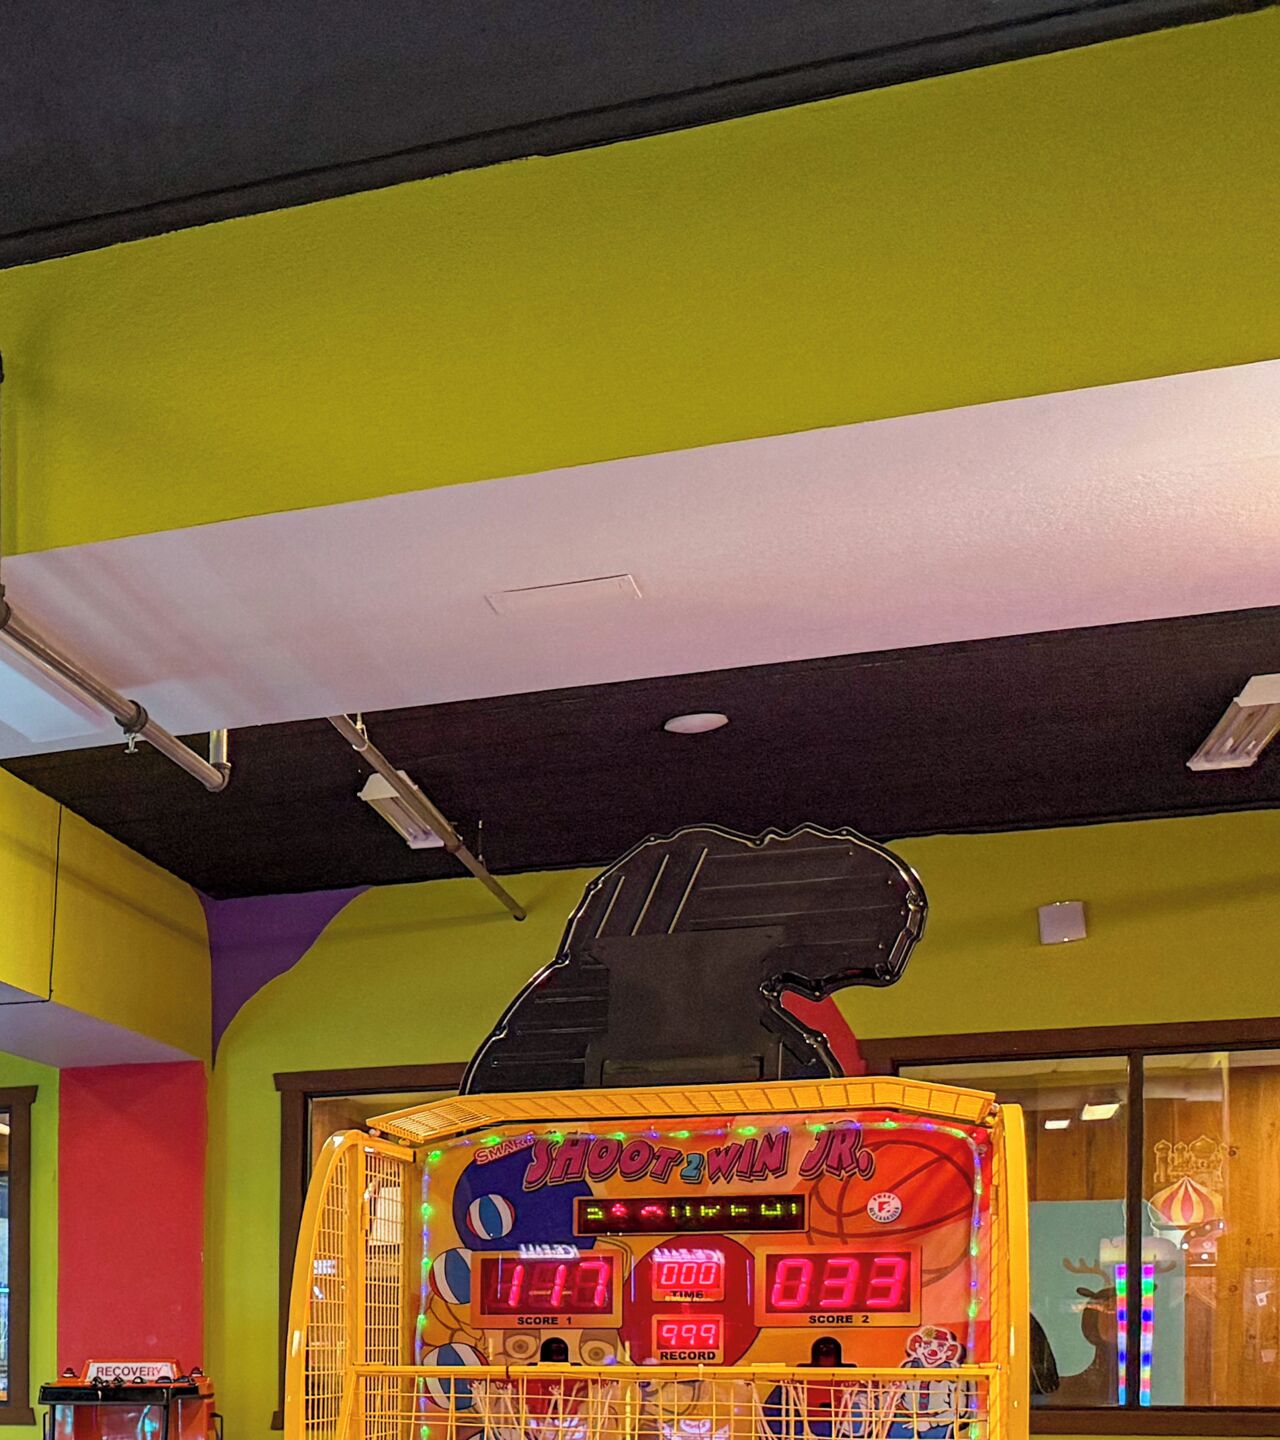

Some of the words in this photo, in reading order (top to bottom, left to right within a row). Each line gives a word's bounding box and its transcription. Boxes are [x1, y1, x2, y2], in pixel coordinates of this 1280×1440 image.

[525, 1132, 680, 1190] SHOOT
[680, 1153, 702, 1181] 2
[707, 1131, 790, 1181] WIN
[800, 1124, 874, 1179] JR.
[661, 1263, 715, 1285] 000
[507, 1262, 610, 1307] 117
[771, 1257, 907, 1309] 033
[671, 1291, 704, 1299] TIME
[517, 1317, 560, 1326] SCORE
[566, 1317, 572, 1325] 1
[808, 1315, 852, 1325] SCORE
[861, 1315, 870, 1324] 2
[661, 1324, 717, 1345] 999
[660, 1351, 716, 1361] RECORD
[96, 1366, 162, 1377] RECOVERY
